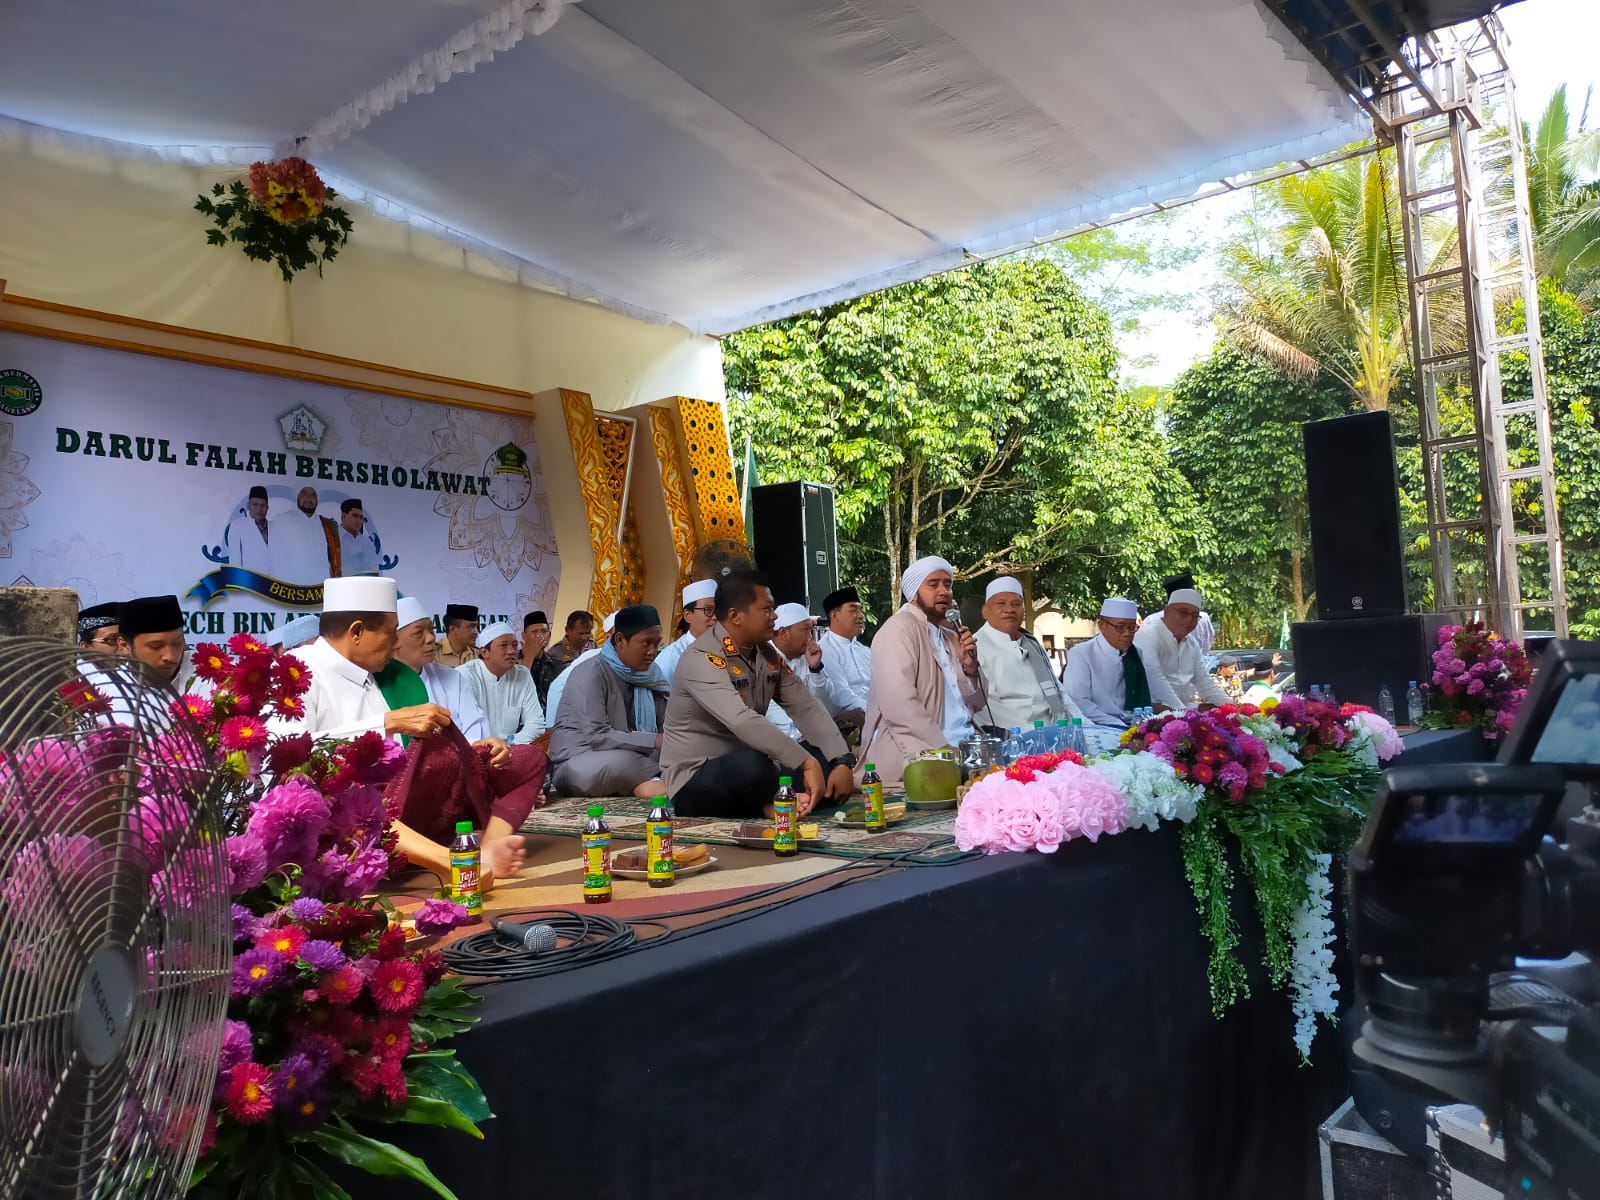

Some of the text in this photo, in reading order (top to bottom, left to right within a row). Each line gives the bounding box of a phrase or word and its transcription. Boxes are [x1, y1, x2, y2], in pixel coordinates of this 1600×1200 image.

[56, 427, 491, 497] DARUL FALAH BERSHOLAWAT
[269, 582, 324, 600] BERSAM
[233, 612, 277, 634] BIN
